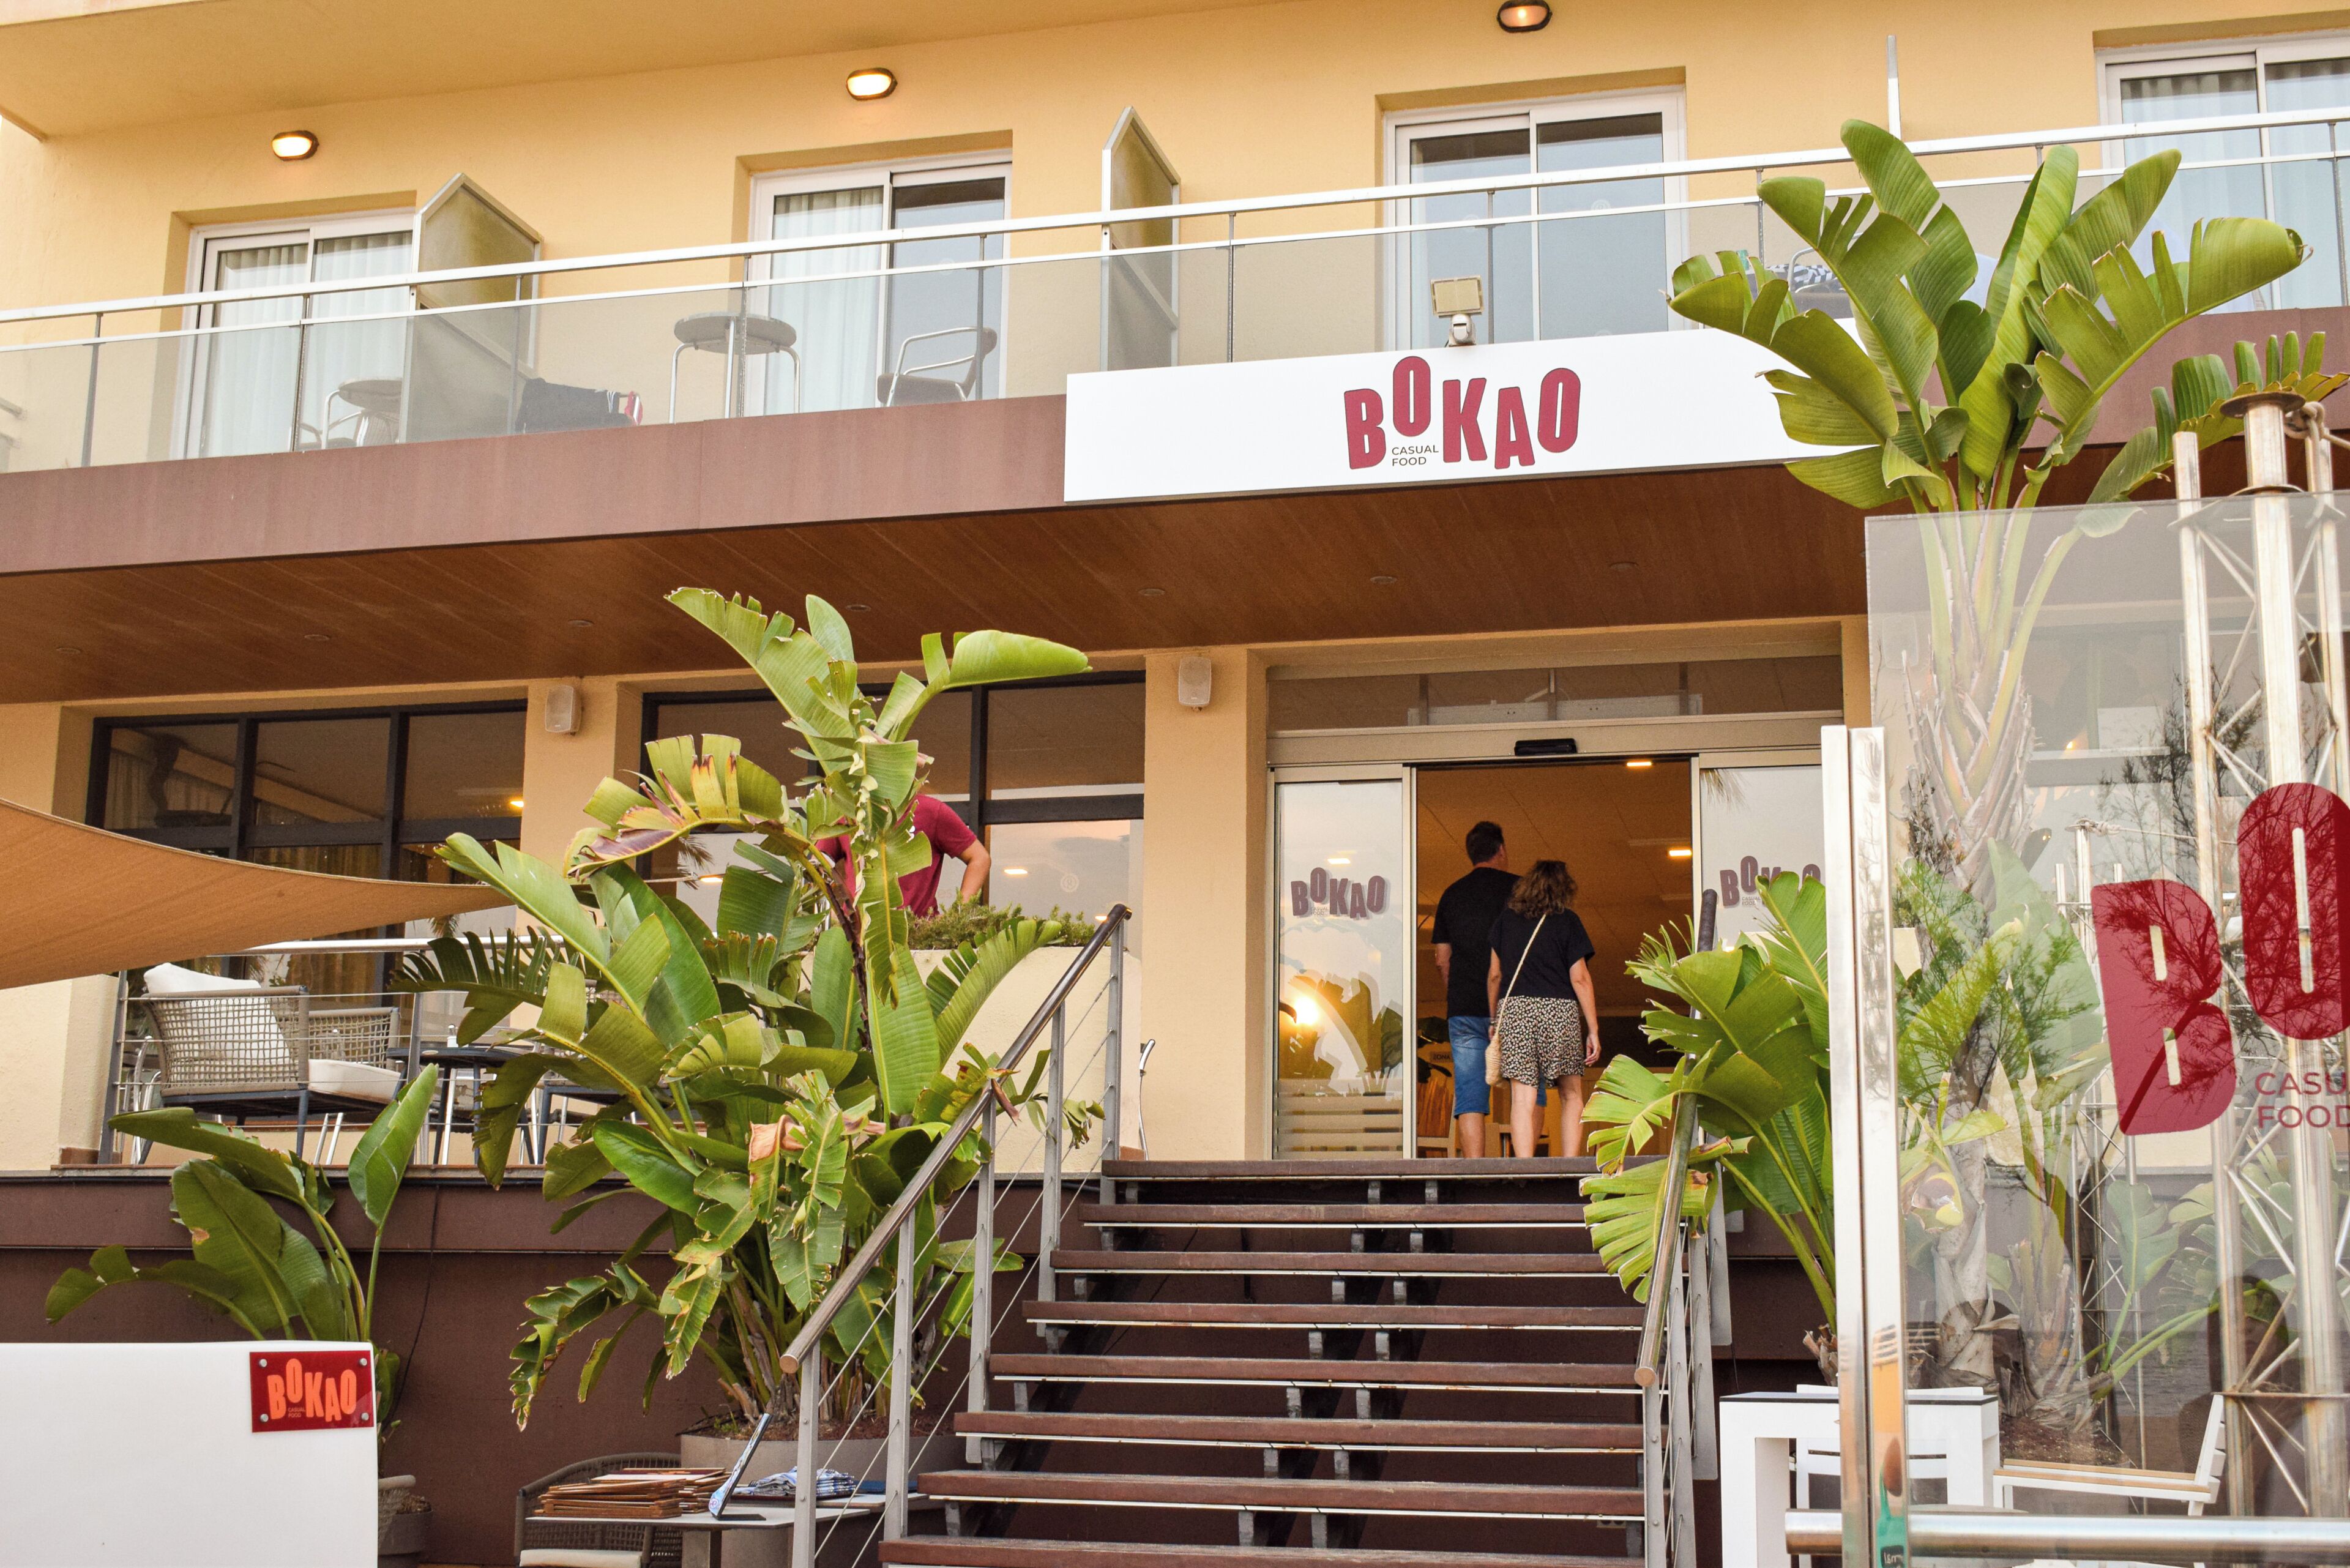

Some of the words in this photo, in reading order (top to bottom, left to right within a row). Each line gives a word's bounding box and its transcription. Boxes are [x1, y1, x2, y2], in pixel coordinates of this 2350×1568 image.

[1344, 356, 1581, 469] BOKAO
[1392, 445, 1439, 455] CASUAL
[1392, 457, 1427, 466] FOOD
[1291, 867, 1385, 918] BOKAO
[267, 1358, 357, 1422] BOKAO
